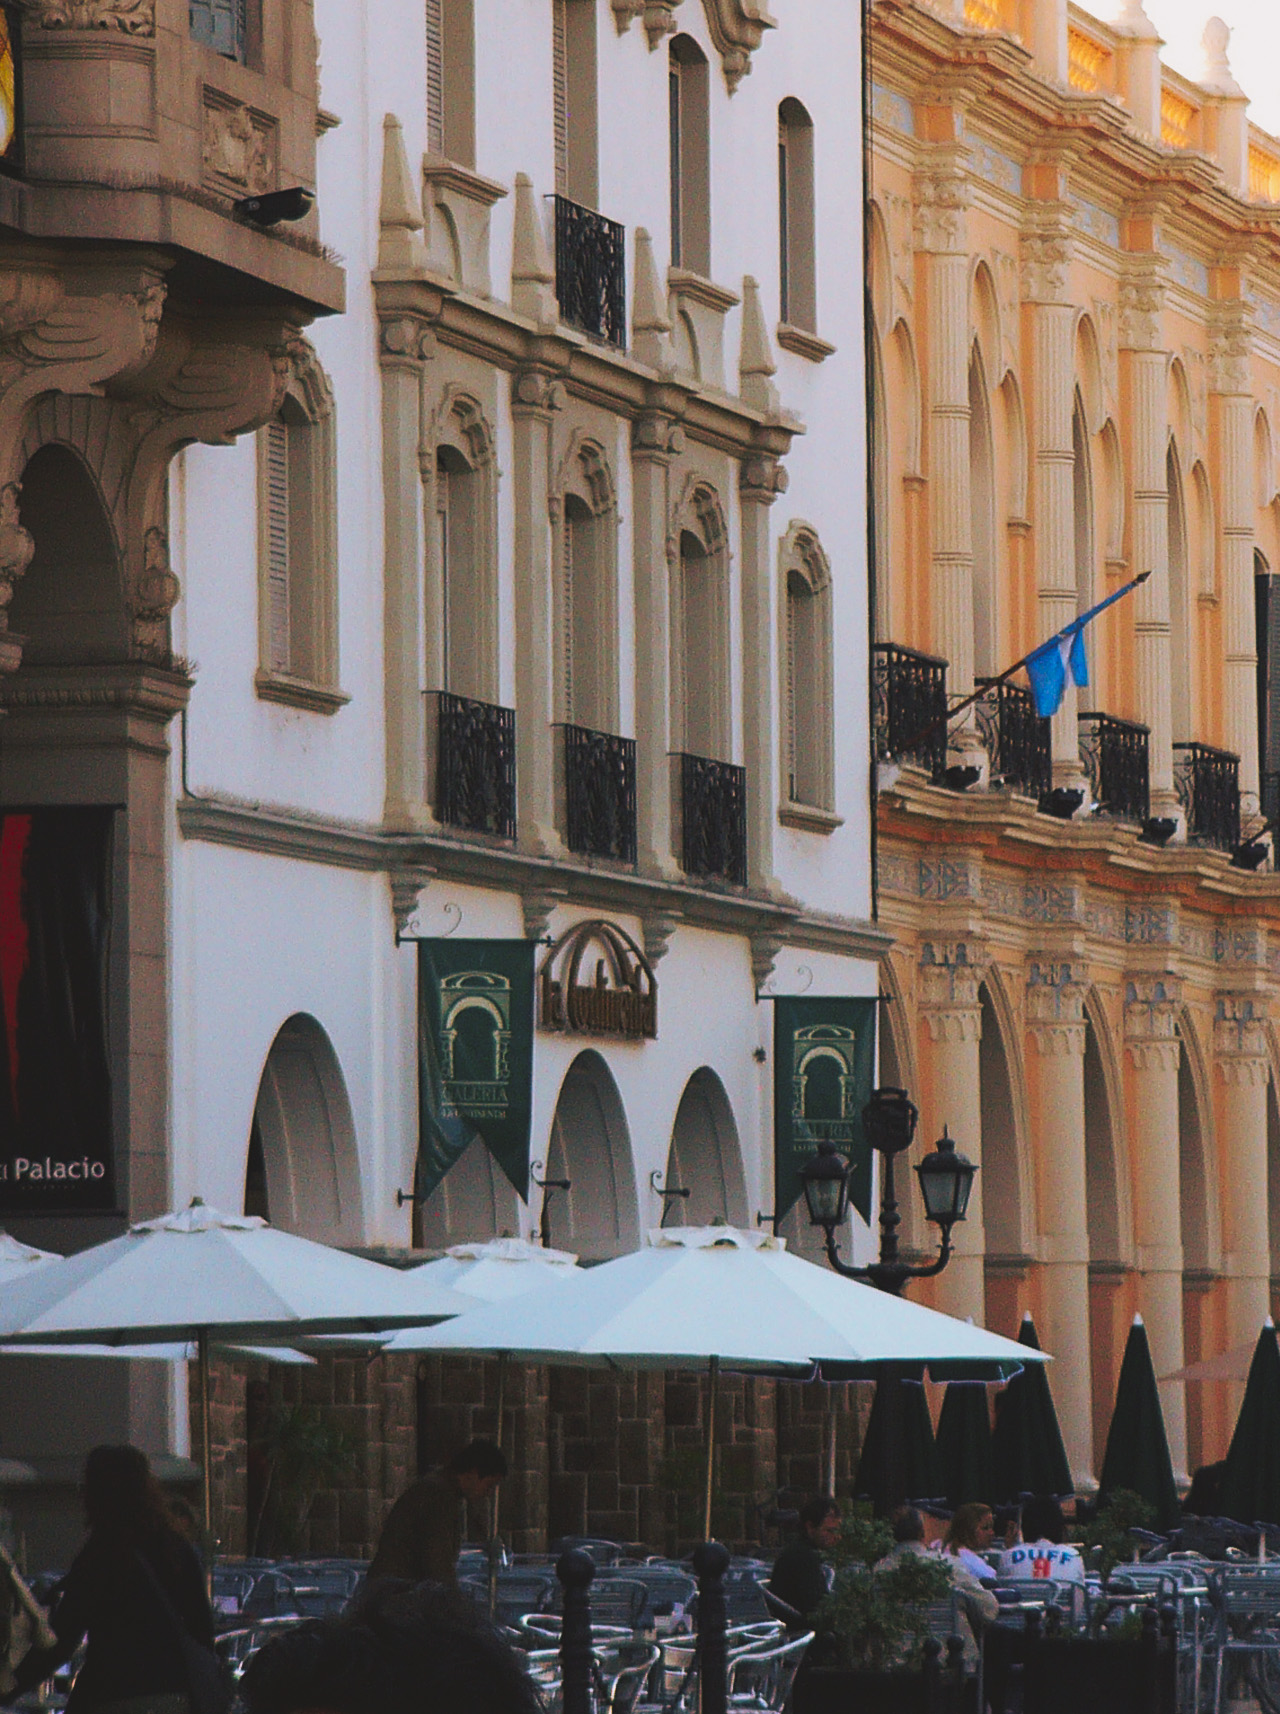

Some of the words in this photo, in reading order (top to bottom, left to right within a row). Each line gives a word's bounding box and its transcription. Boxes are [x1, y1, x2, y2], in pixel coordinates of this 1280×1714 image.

[441, 1086, 508, 1102] GALERIA
[14, 1156, 106, 1180] Palacio
[1011, 1548, 1075, 1565] DUFF
